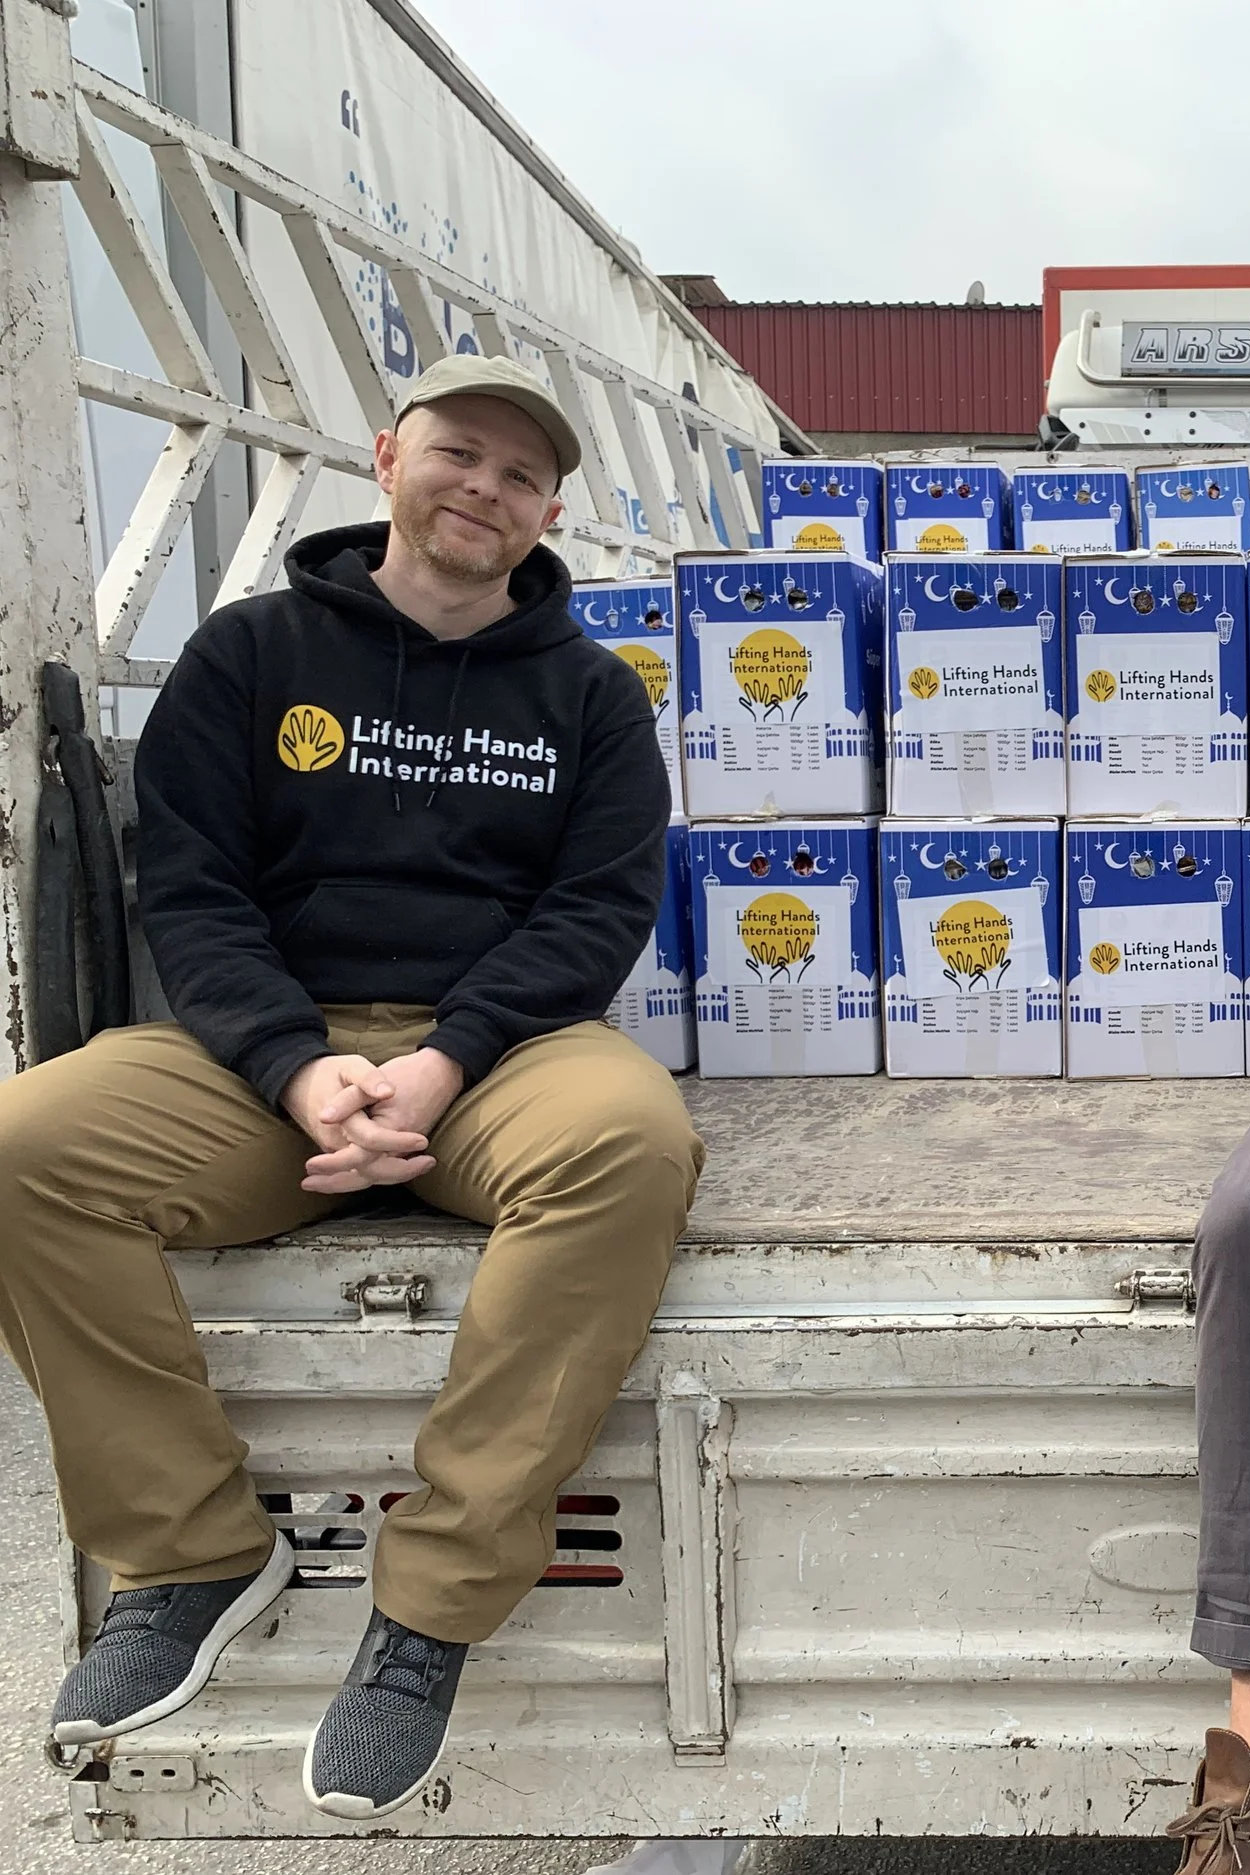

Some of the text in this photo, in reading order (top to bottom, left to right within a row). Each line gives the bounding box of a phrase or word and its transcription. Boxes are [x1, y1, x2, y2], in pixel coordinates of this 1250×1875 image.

[791, 533, 845, 546] Lifting Hands
[915, 534, 969, 546] Lifting Hands
[1083, 543, 1112, 552] Hands
[1209, 541, 1237, 550] Hands
[728, 646, 812, 663] Lifting Hands
[635, 658, 672, 671] Hands
[729, 661, 812, 674] International
[942, 663, 1037, 684] Lifting Hands
[1120, 669, 1213, 688] Lifting Hands
[944, 680, 1038, 697] International
[1120, 686, 1214, 701] International
[352, 715, 558, 764] Lifting Hands
[348, 747, 556, 794] International
[736, 909, 821, 926] Lifting Hands
[929, 914, 1013, 934] Lifting Hands
[737, 923, 820, 936] International
[931, 928, 1014, 947] International
[1123, 939, 1218, 959] Lifting Hands
[1124, 954, 1218, 972] International
